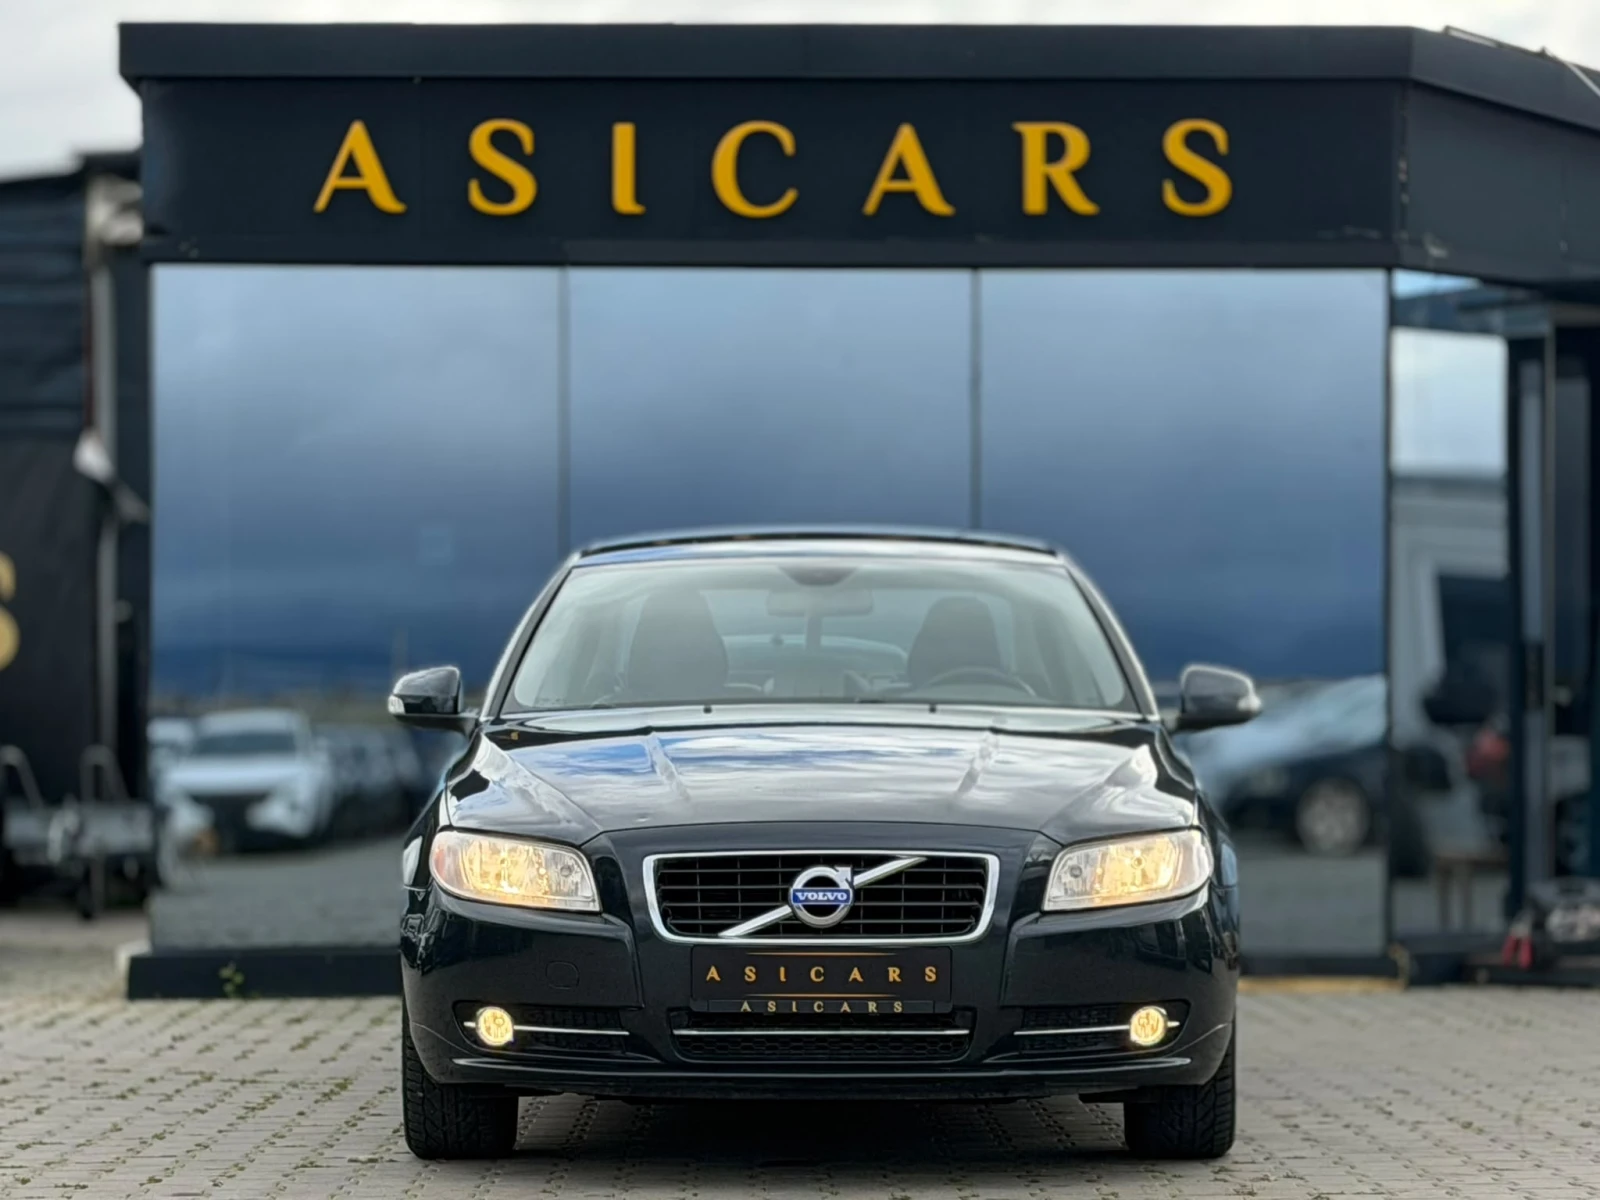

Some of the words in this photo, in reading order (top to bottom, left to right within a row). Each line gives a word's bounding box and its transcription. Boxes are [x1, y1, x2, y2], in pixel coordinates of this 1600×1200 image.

[313, 118, 1234, 219] ASICARS
[795, 891, 848, 901] VOLVO
[706, 966, 938, 983] ASICARS
[740, 1001, 903, 1013] ASICARS
